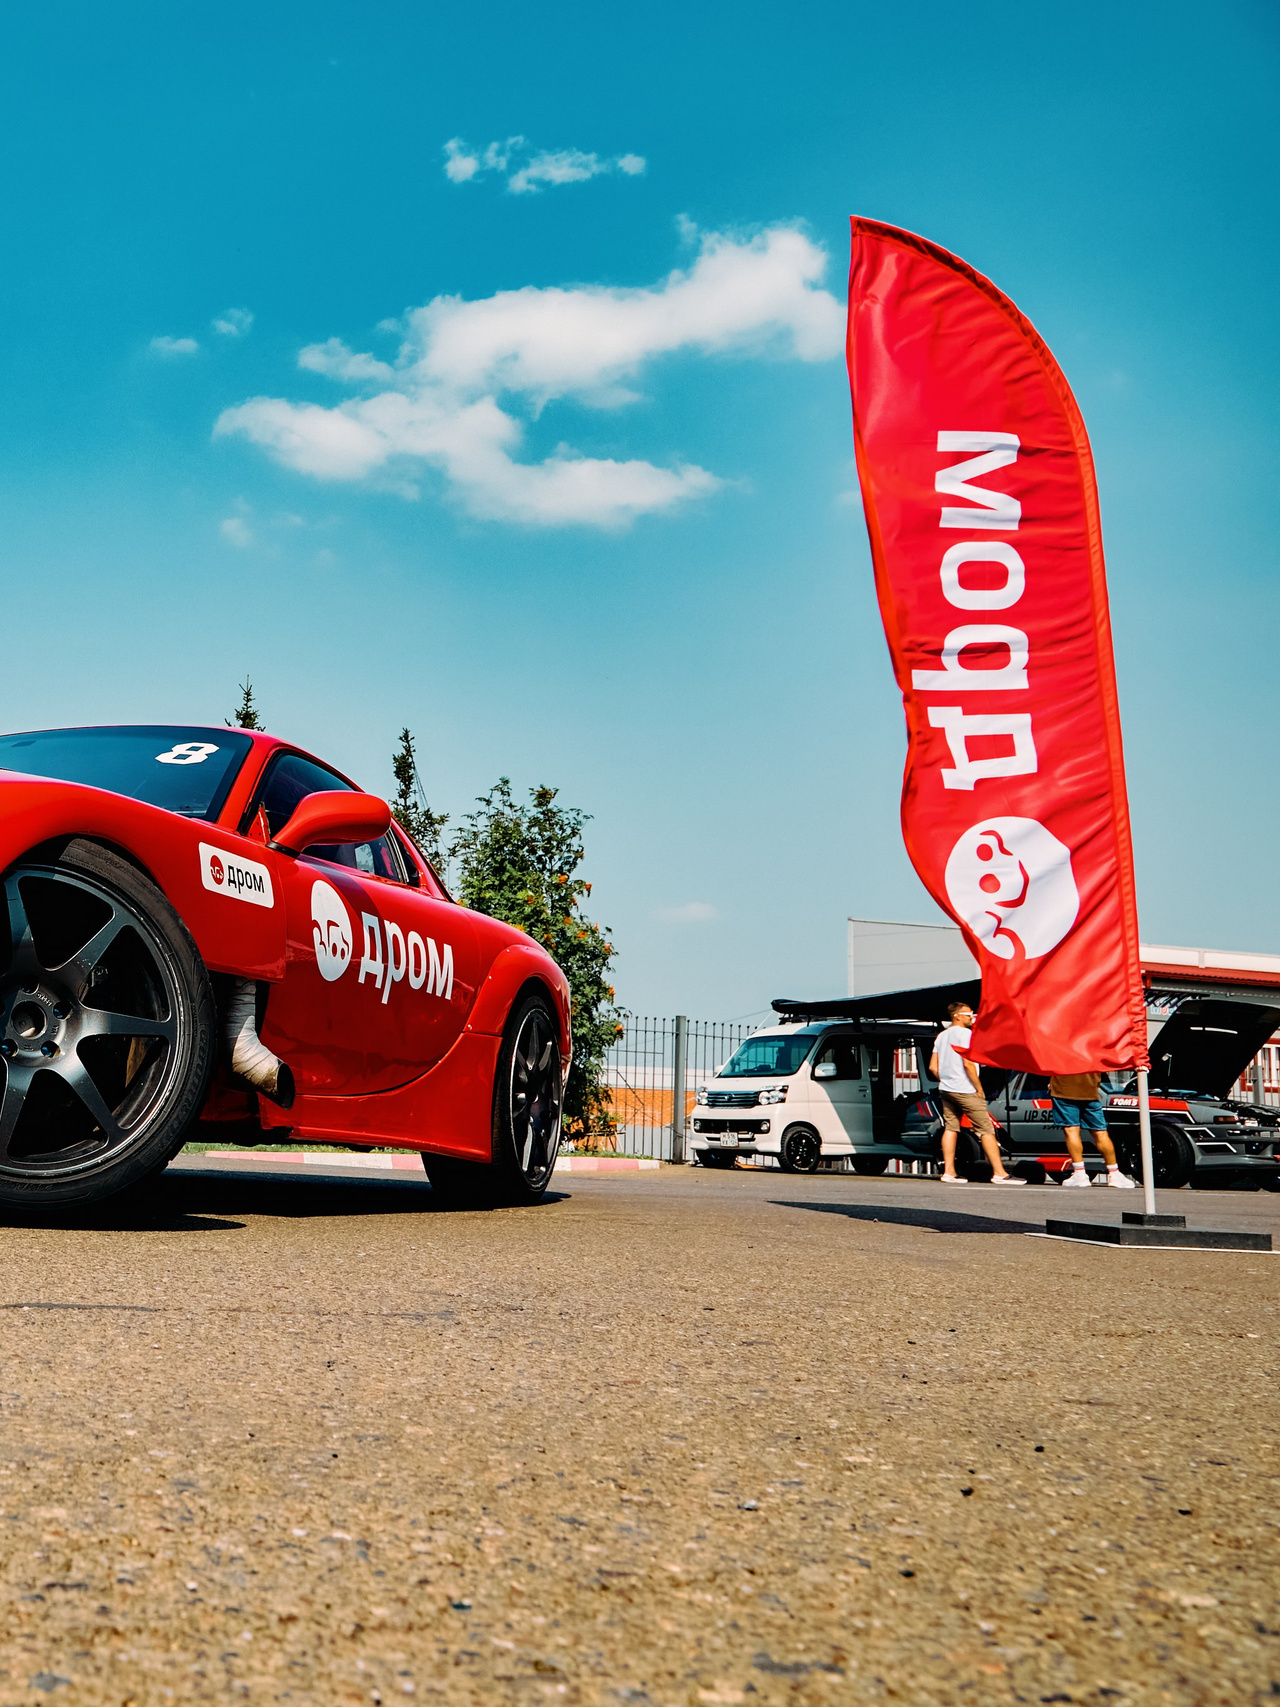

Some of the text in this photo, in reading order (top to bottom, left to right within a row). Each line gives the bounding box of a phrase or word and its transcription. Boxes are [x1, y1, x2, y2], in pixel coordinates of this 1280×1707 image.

[154, 742, 220, 765] 8
[227, 864, 265, 894] дром
[358, 911, 454, 1004] дром
[1024, 1110, 1039, 1121] UP
